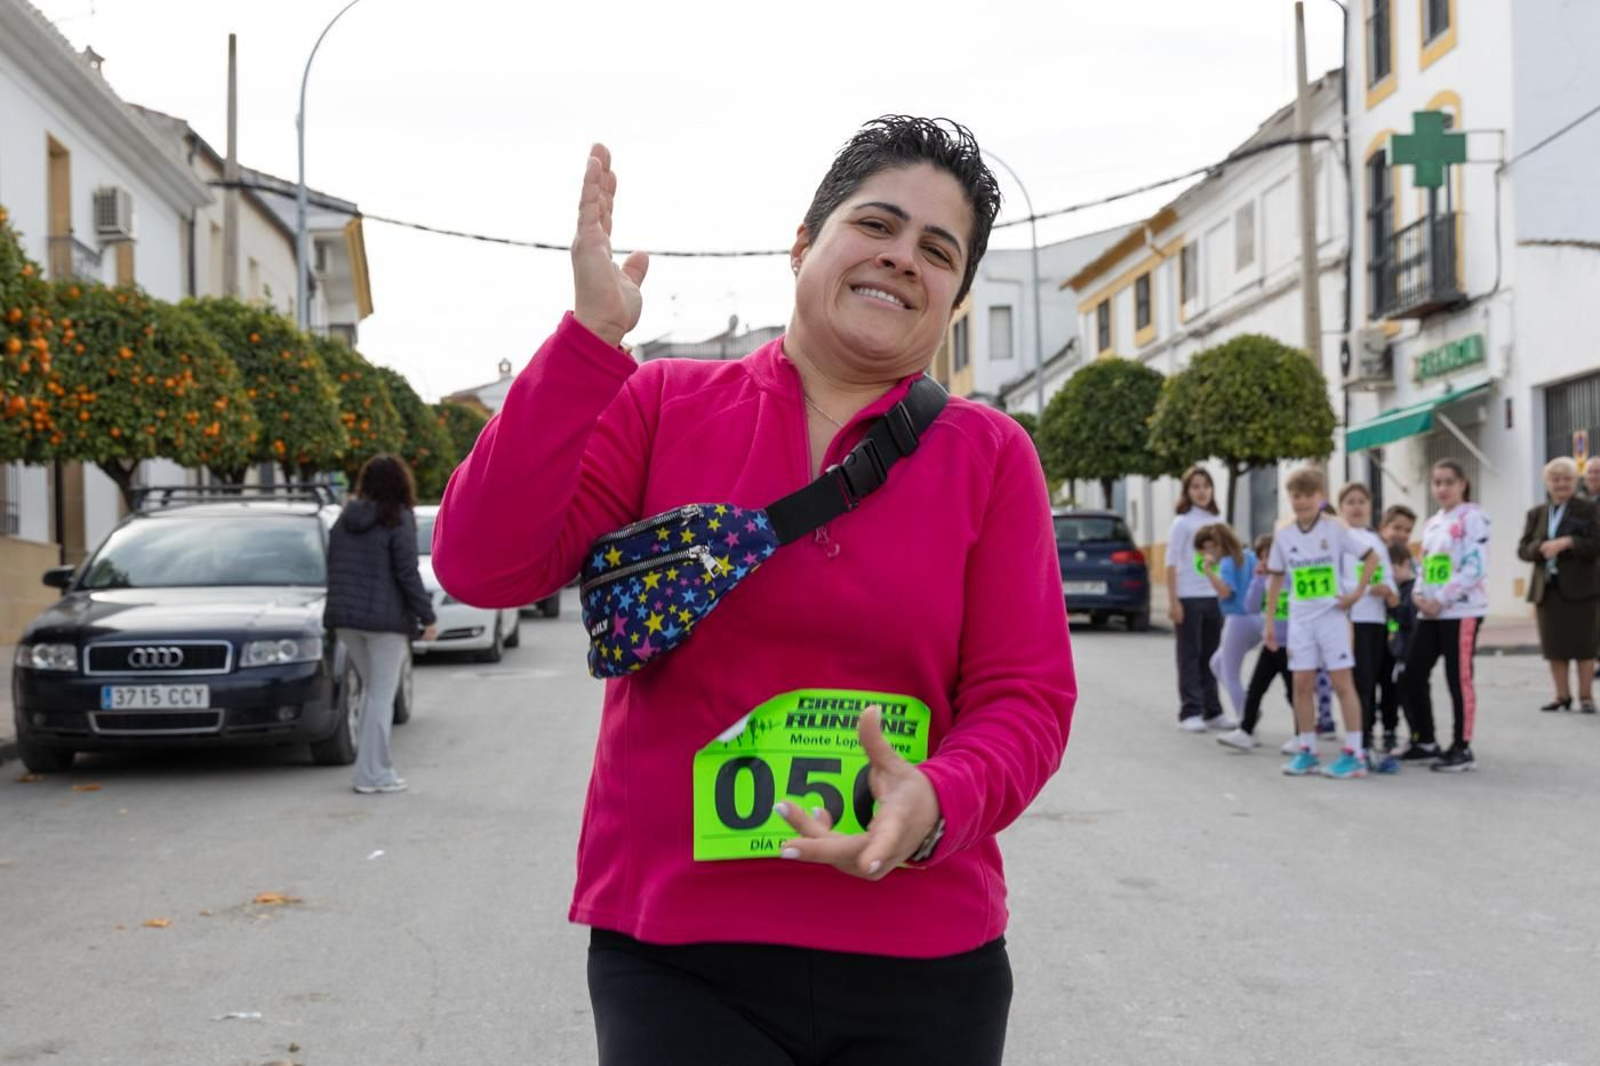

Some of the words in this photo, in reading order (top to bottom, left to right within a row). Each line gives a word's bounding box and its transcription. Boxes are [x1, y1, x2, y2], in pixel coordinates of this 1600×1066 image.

[1297, 579, 1330, 596] 011
[115, 687, 161, 706] 3715
[168, 687, 204, 705] CCY
[797, 697, 908, 717] CIRCUTO
[784, 711, 919, 739] RUNNG
[790, 733, 831, 746] Monte
[836, 735, 861, 750] Lop
[750, 835, 774, 851] DÍA
